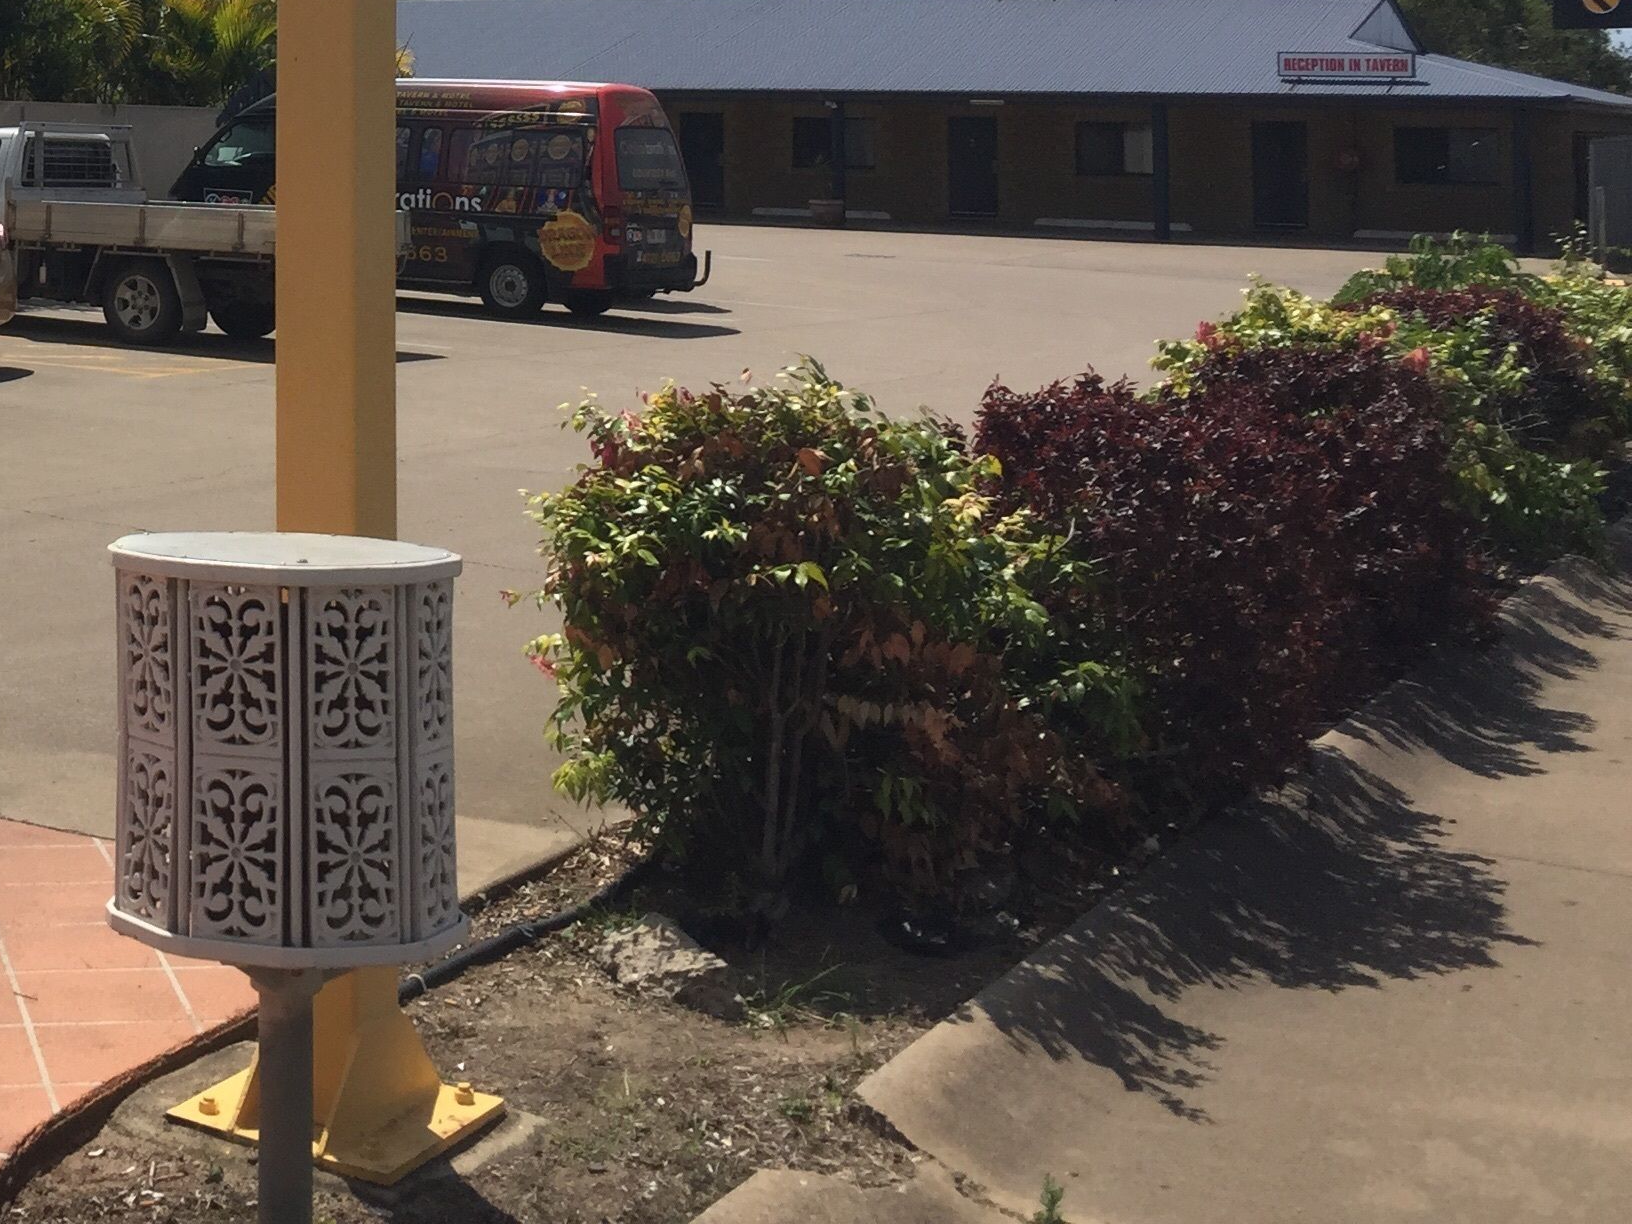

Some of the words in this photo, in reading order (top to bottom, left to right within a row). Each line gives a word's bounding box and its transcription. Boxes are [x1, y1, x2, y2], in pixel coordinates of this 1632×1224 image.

[1284, 58, 1345, 72] RECEPTION
[1349, 58, 1361, 72] IN
[1365, 58, 1409, 73] TAVERN
